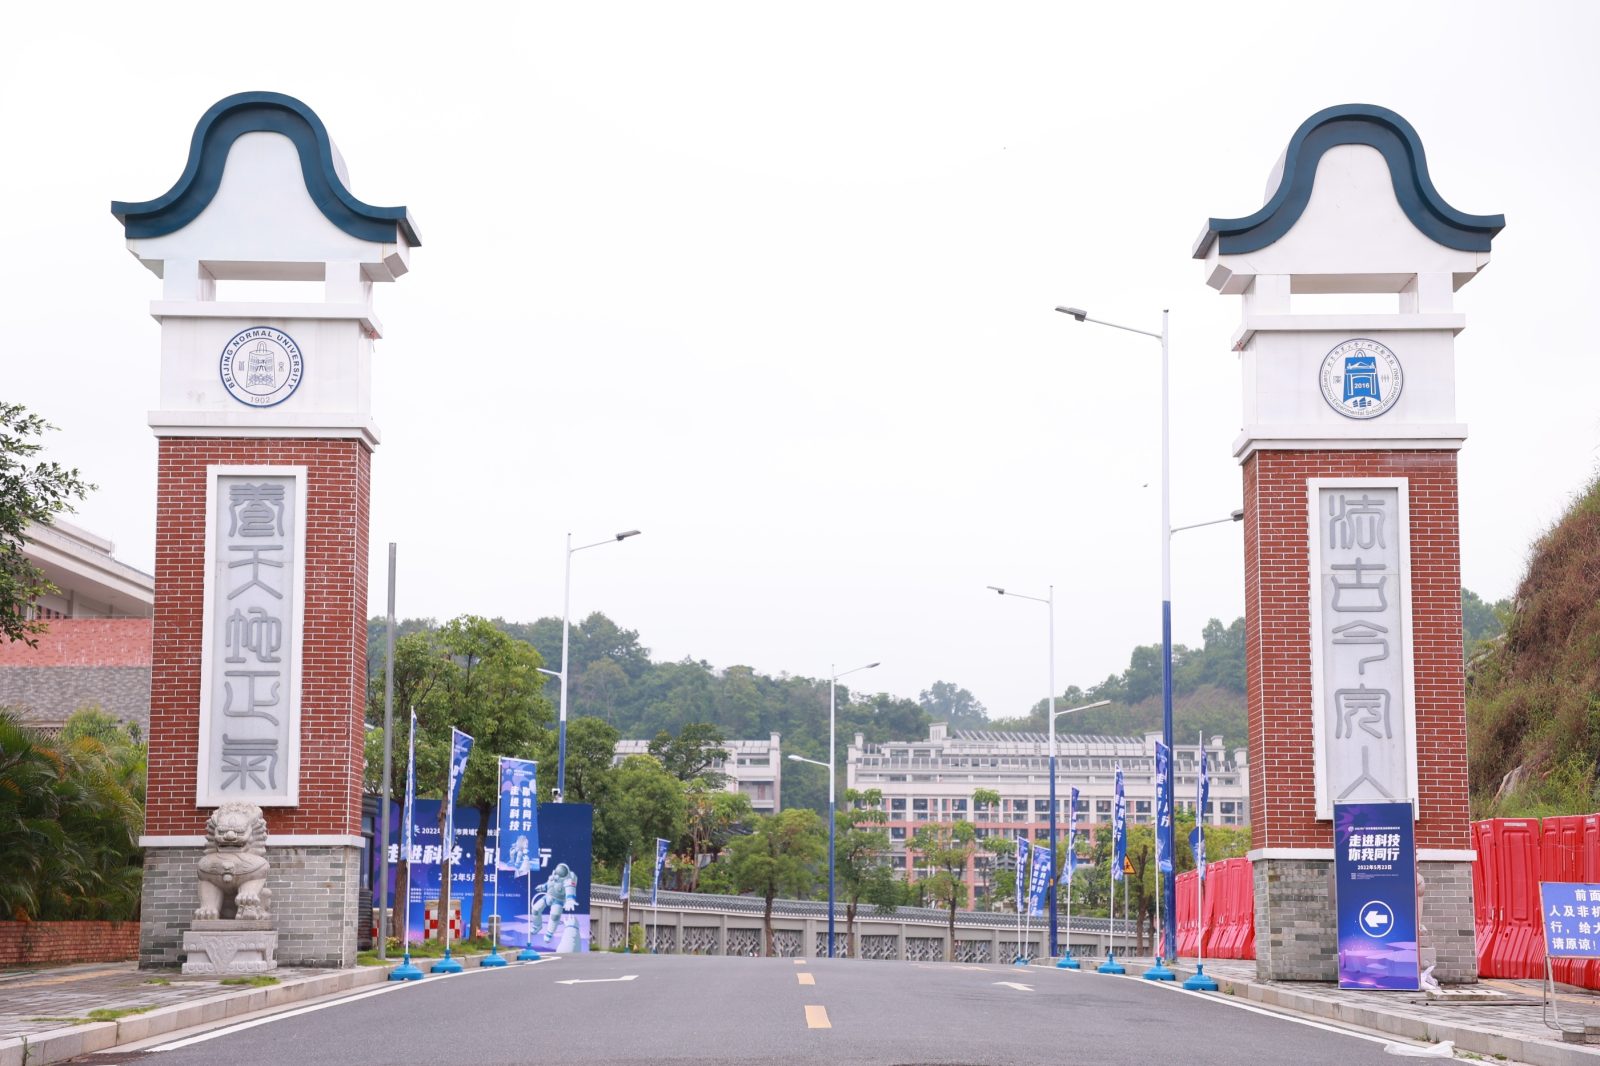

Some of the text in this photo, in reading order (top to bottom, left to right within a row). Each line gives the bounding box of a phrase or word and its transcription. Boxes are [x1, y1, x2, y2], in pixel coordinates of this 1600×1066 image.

[223, 330, 300, 389] BEIJING NORMAL UNIVERSITY
[250, 396, 271, 404] 1902
[1349, 834, 1400, 847] 走进科技
[1348, 848, 1400, 861] 你我同行
[1574, 889, 1600, 901] 前面
